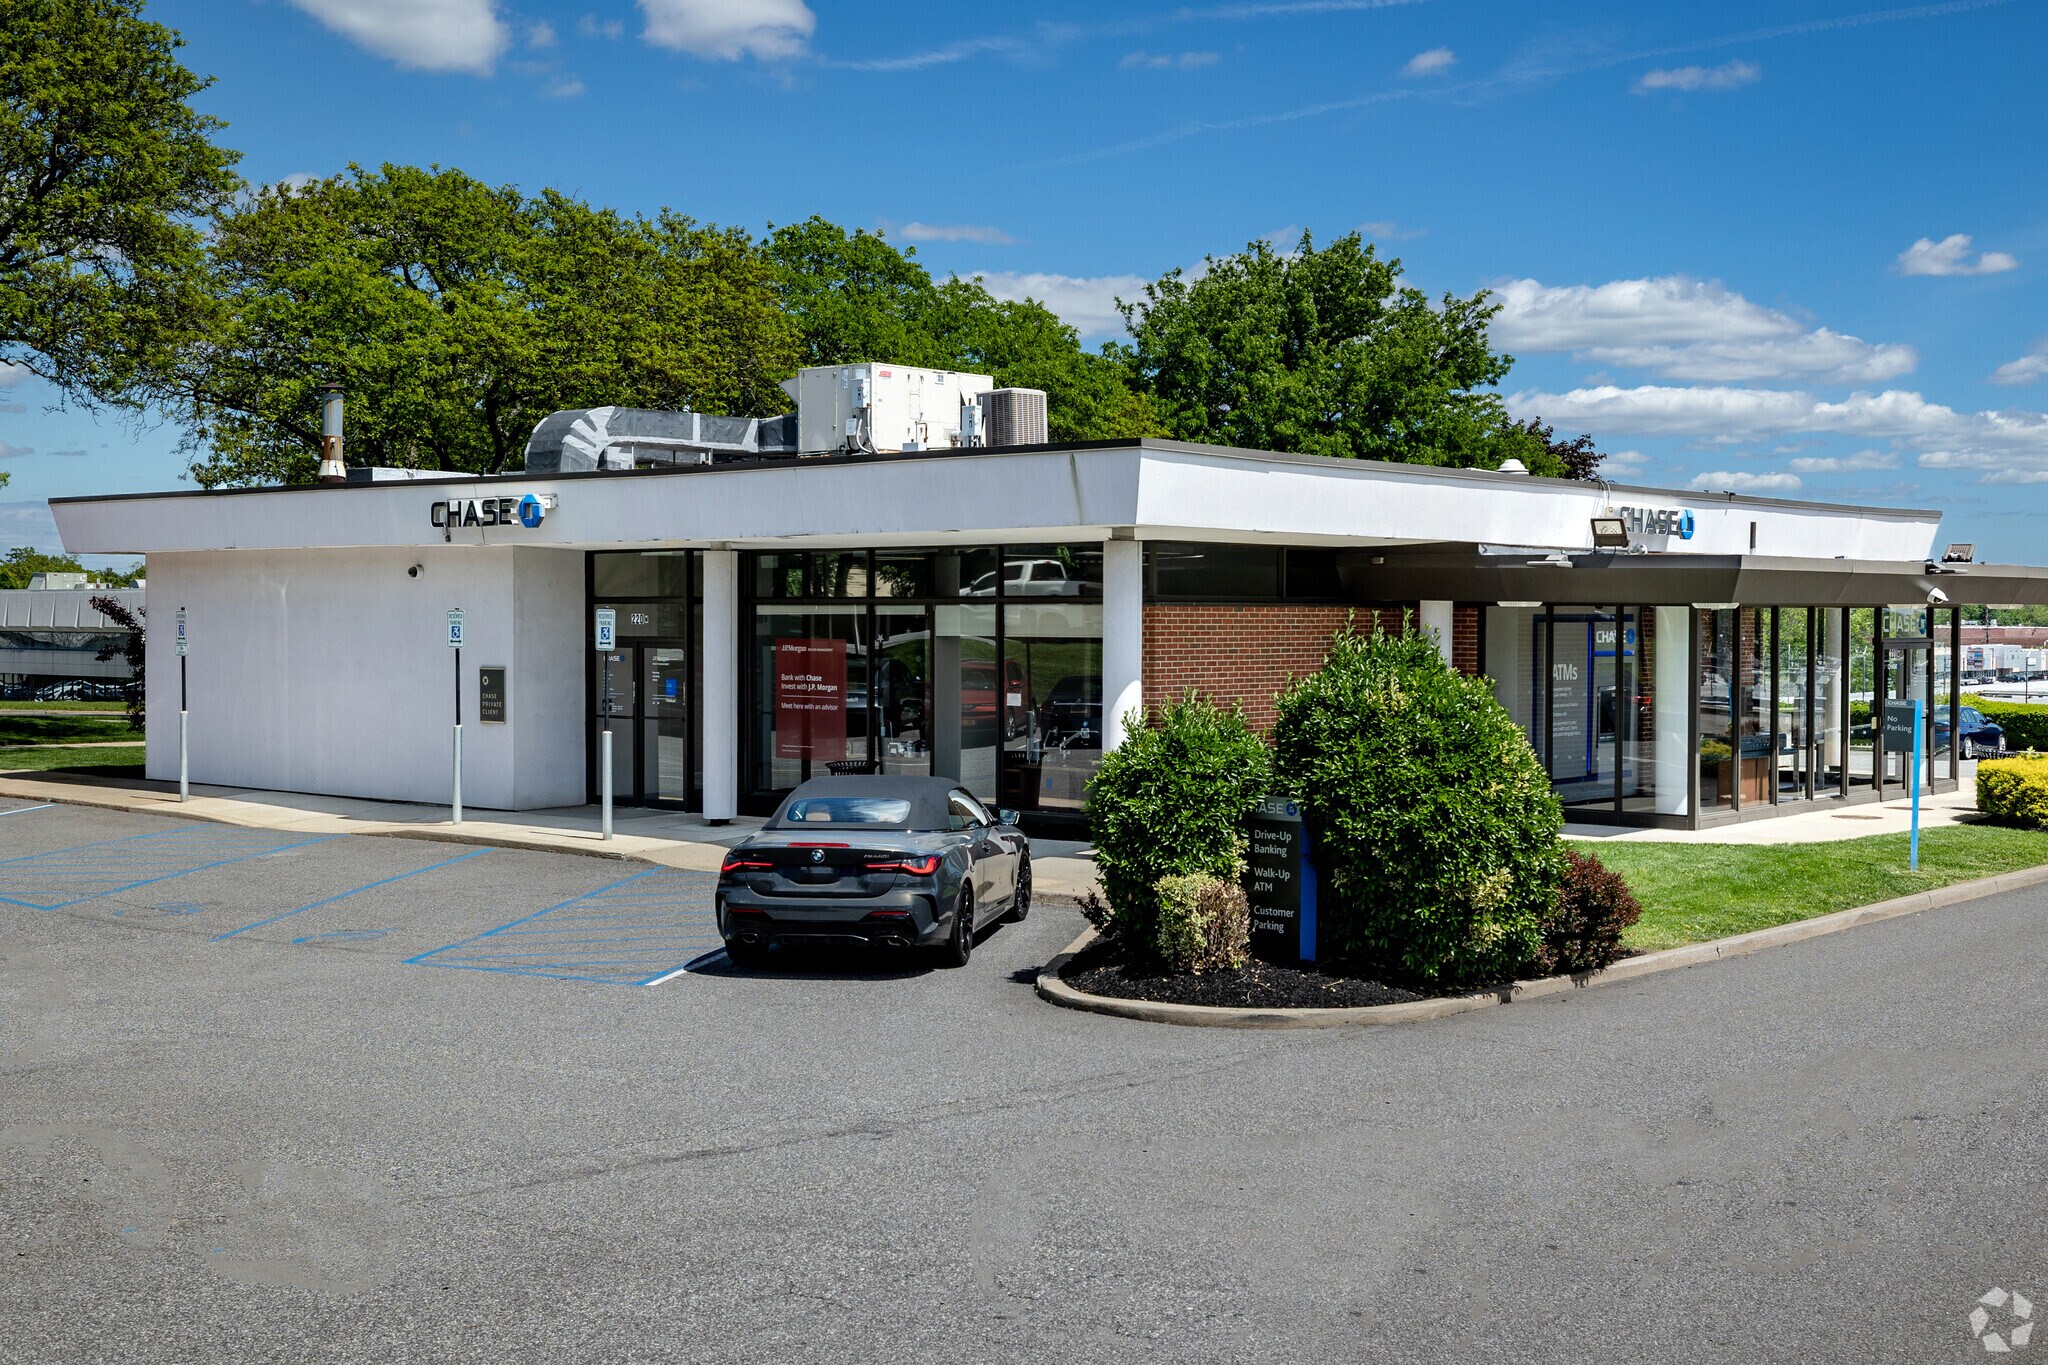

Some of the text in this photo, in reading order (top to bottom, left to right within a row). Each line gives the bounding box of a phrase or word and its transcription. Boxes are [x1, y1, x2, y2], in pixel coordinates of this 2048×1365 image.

[431, 498, 514, 528] CHASE
[781, 673, 794, 681] Bank
[1553, 664, 1578, 681] ATMs
[817, 684, 838, 692] Morgan
[1886, 724, 1912, 734] Parking
[1257, 803, 1284, 815] ASE
[1254, 829, 1292, 843] Drive-Up
[1254, 844, 1287, 858] Banking
[1254, 866, 1291, 881] Walk-Up
[1254, 881, 1273, 892] ATM
[1254, 905, 1295, 918] Customer
[1254, 919, 1284, 934] Parking
